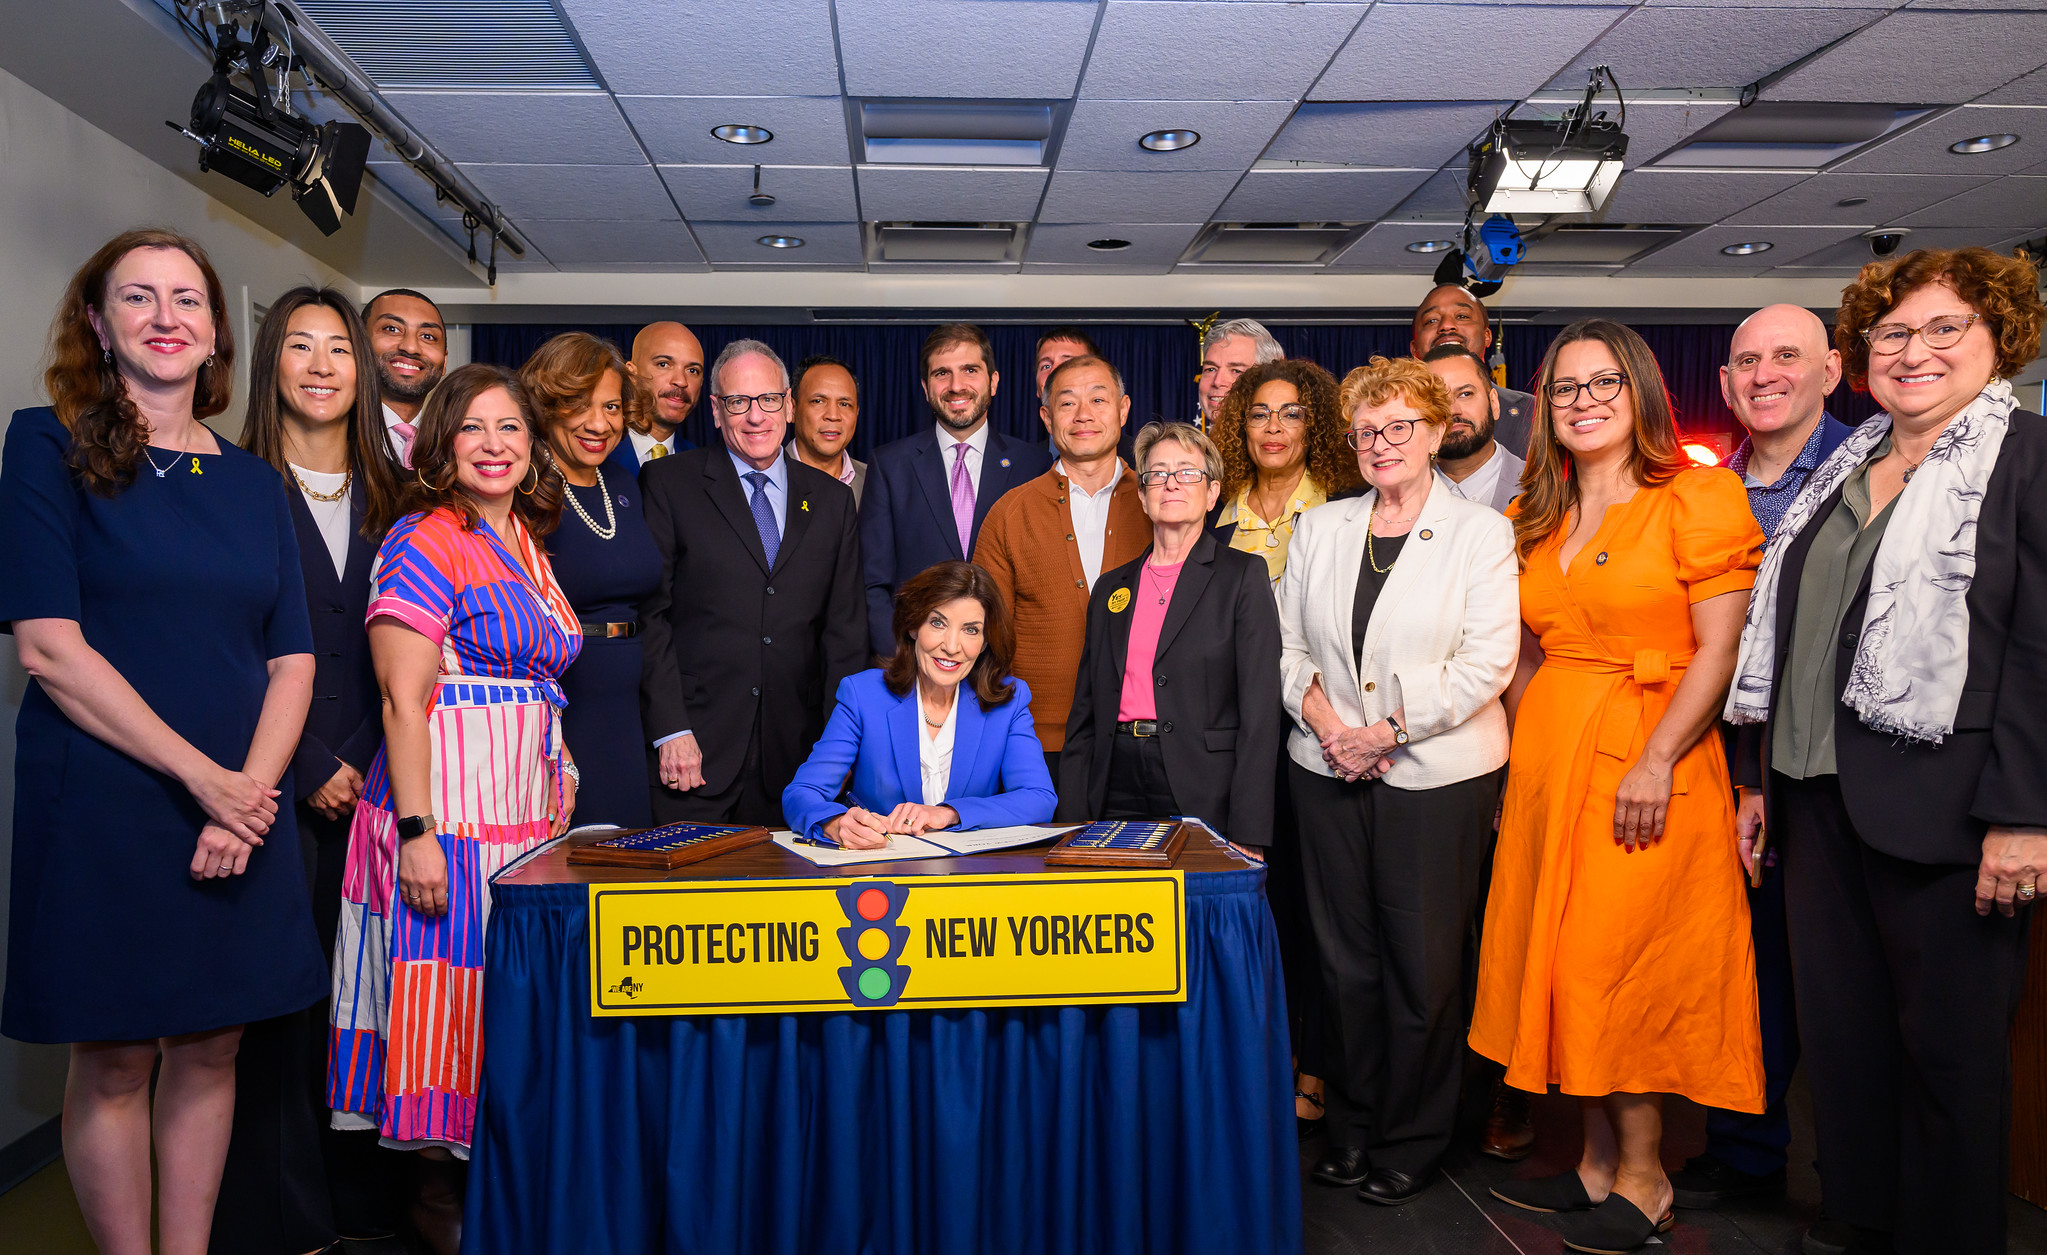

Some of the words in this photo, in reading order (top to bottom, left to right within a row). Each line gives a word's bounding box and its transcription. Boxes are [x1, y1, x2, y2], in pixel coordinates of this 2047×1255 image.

[228, 136, 260, 156] HELIA
[262, 153, 282, 167] LED
[622, 921, 819, 966] PROTECTING
[925, 917, 997, 959] NEW
[1007, 912, 1154, 956] YORKERS
[633, 982, 644, 992] NY
